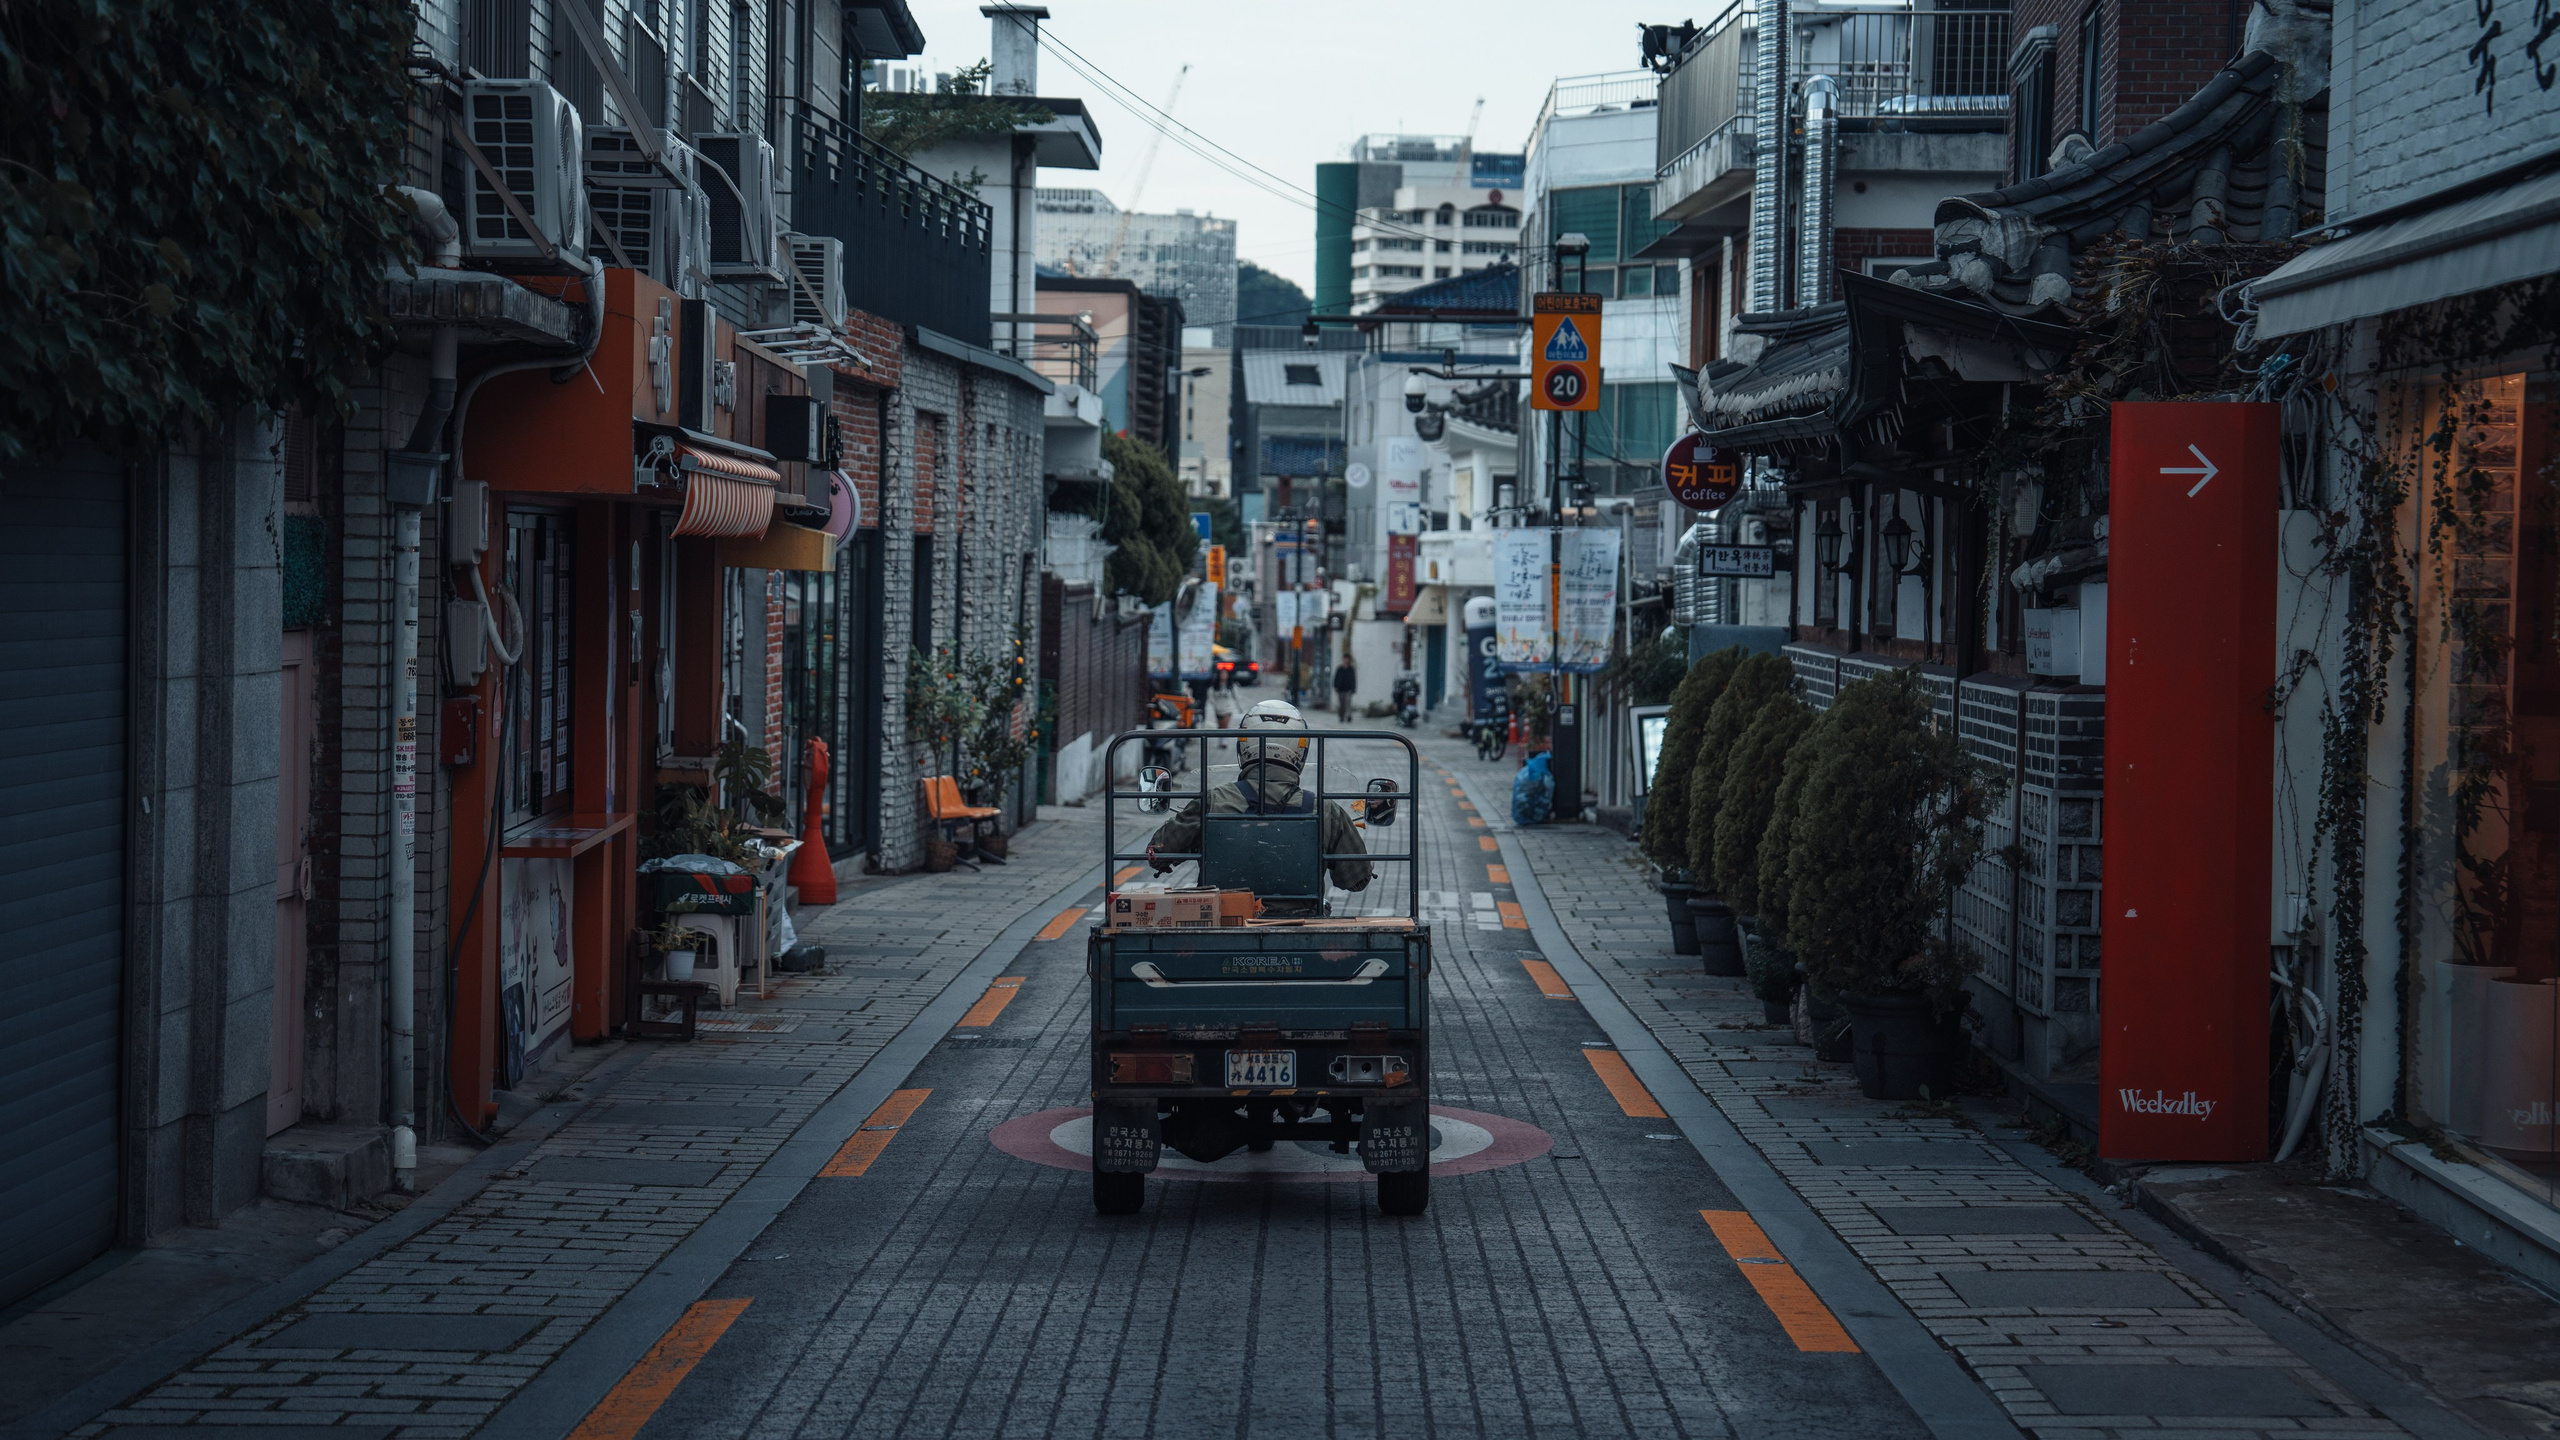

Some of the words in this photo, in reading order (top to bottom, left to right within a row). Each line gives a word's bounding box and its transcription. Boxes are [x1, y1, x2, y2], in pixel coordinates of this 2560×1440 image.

[1537, 296, 1598, 311] 어린이보호구역
[1548, 350, 1584, 359] 어린이보호
[1553, 375, 1578, 397] 20
[1670, 463, 1736, 487] 커피
[1682, 488, 1726, 500] Coffee
[690, 893, 732, 905] 로켓프레시
[1232, 956, 1290, 966] KOREA
[1231, 1071, 1242, 1082] 카
[1245, 1066, 1290, 1083] 4416
[2119, 1088, 2218, 1122] Weekalley
